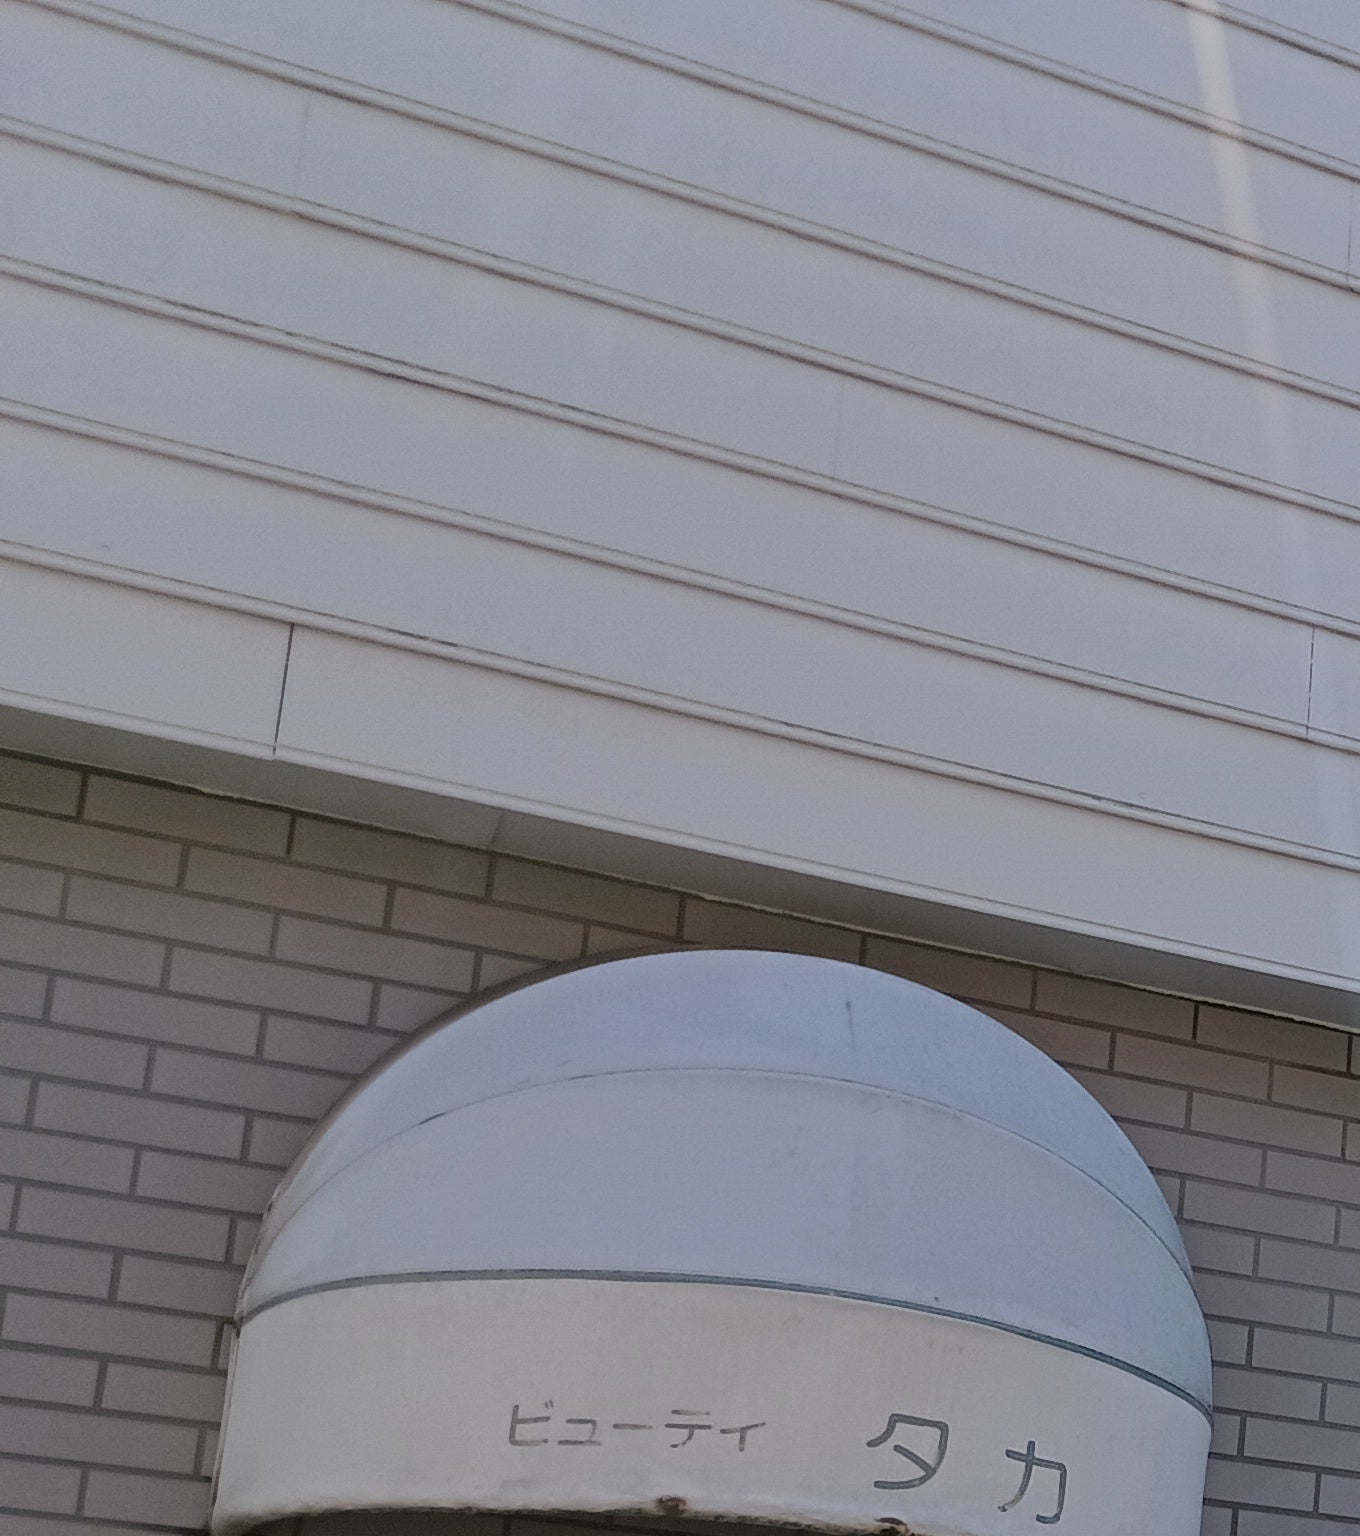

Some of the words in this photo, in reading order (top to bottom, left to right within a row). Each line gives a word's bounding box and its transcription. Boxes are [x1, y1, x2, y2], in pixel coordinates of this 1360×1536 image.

[508, 1399, 766, 1452] ビューティ
[866, 1411, 1068, 1524] タカ
